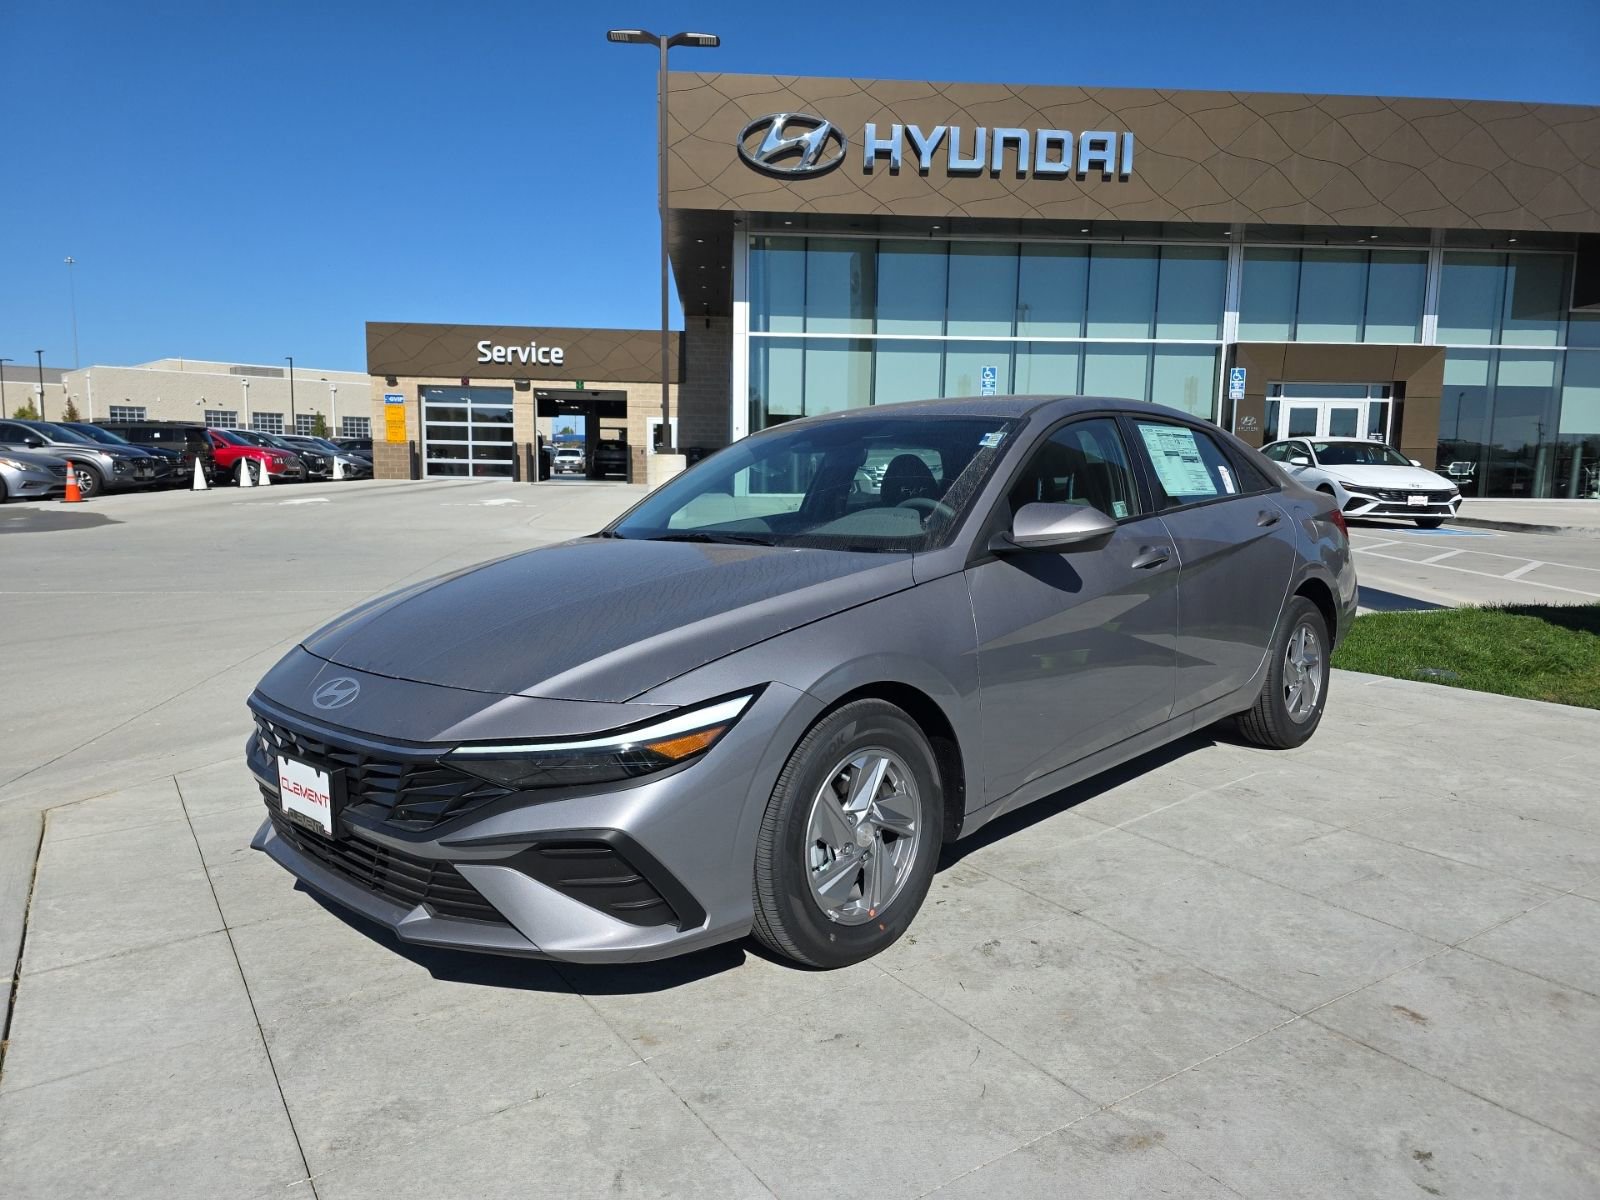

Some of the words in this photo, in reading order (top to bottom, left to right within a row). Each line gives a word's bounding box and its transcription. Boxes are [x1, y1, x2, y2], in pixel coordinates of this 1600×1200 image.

[864, 122, 1134, 176] HYUNDAI
[477, 340, 564, 364] Service
[282, 777, 329, 807] CLEMENT
